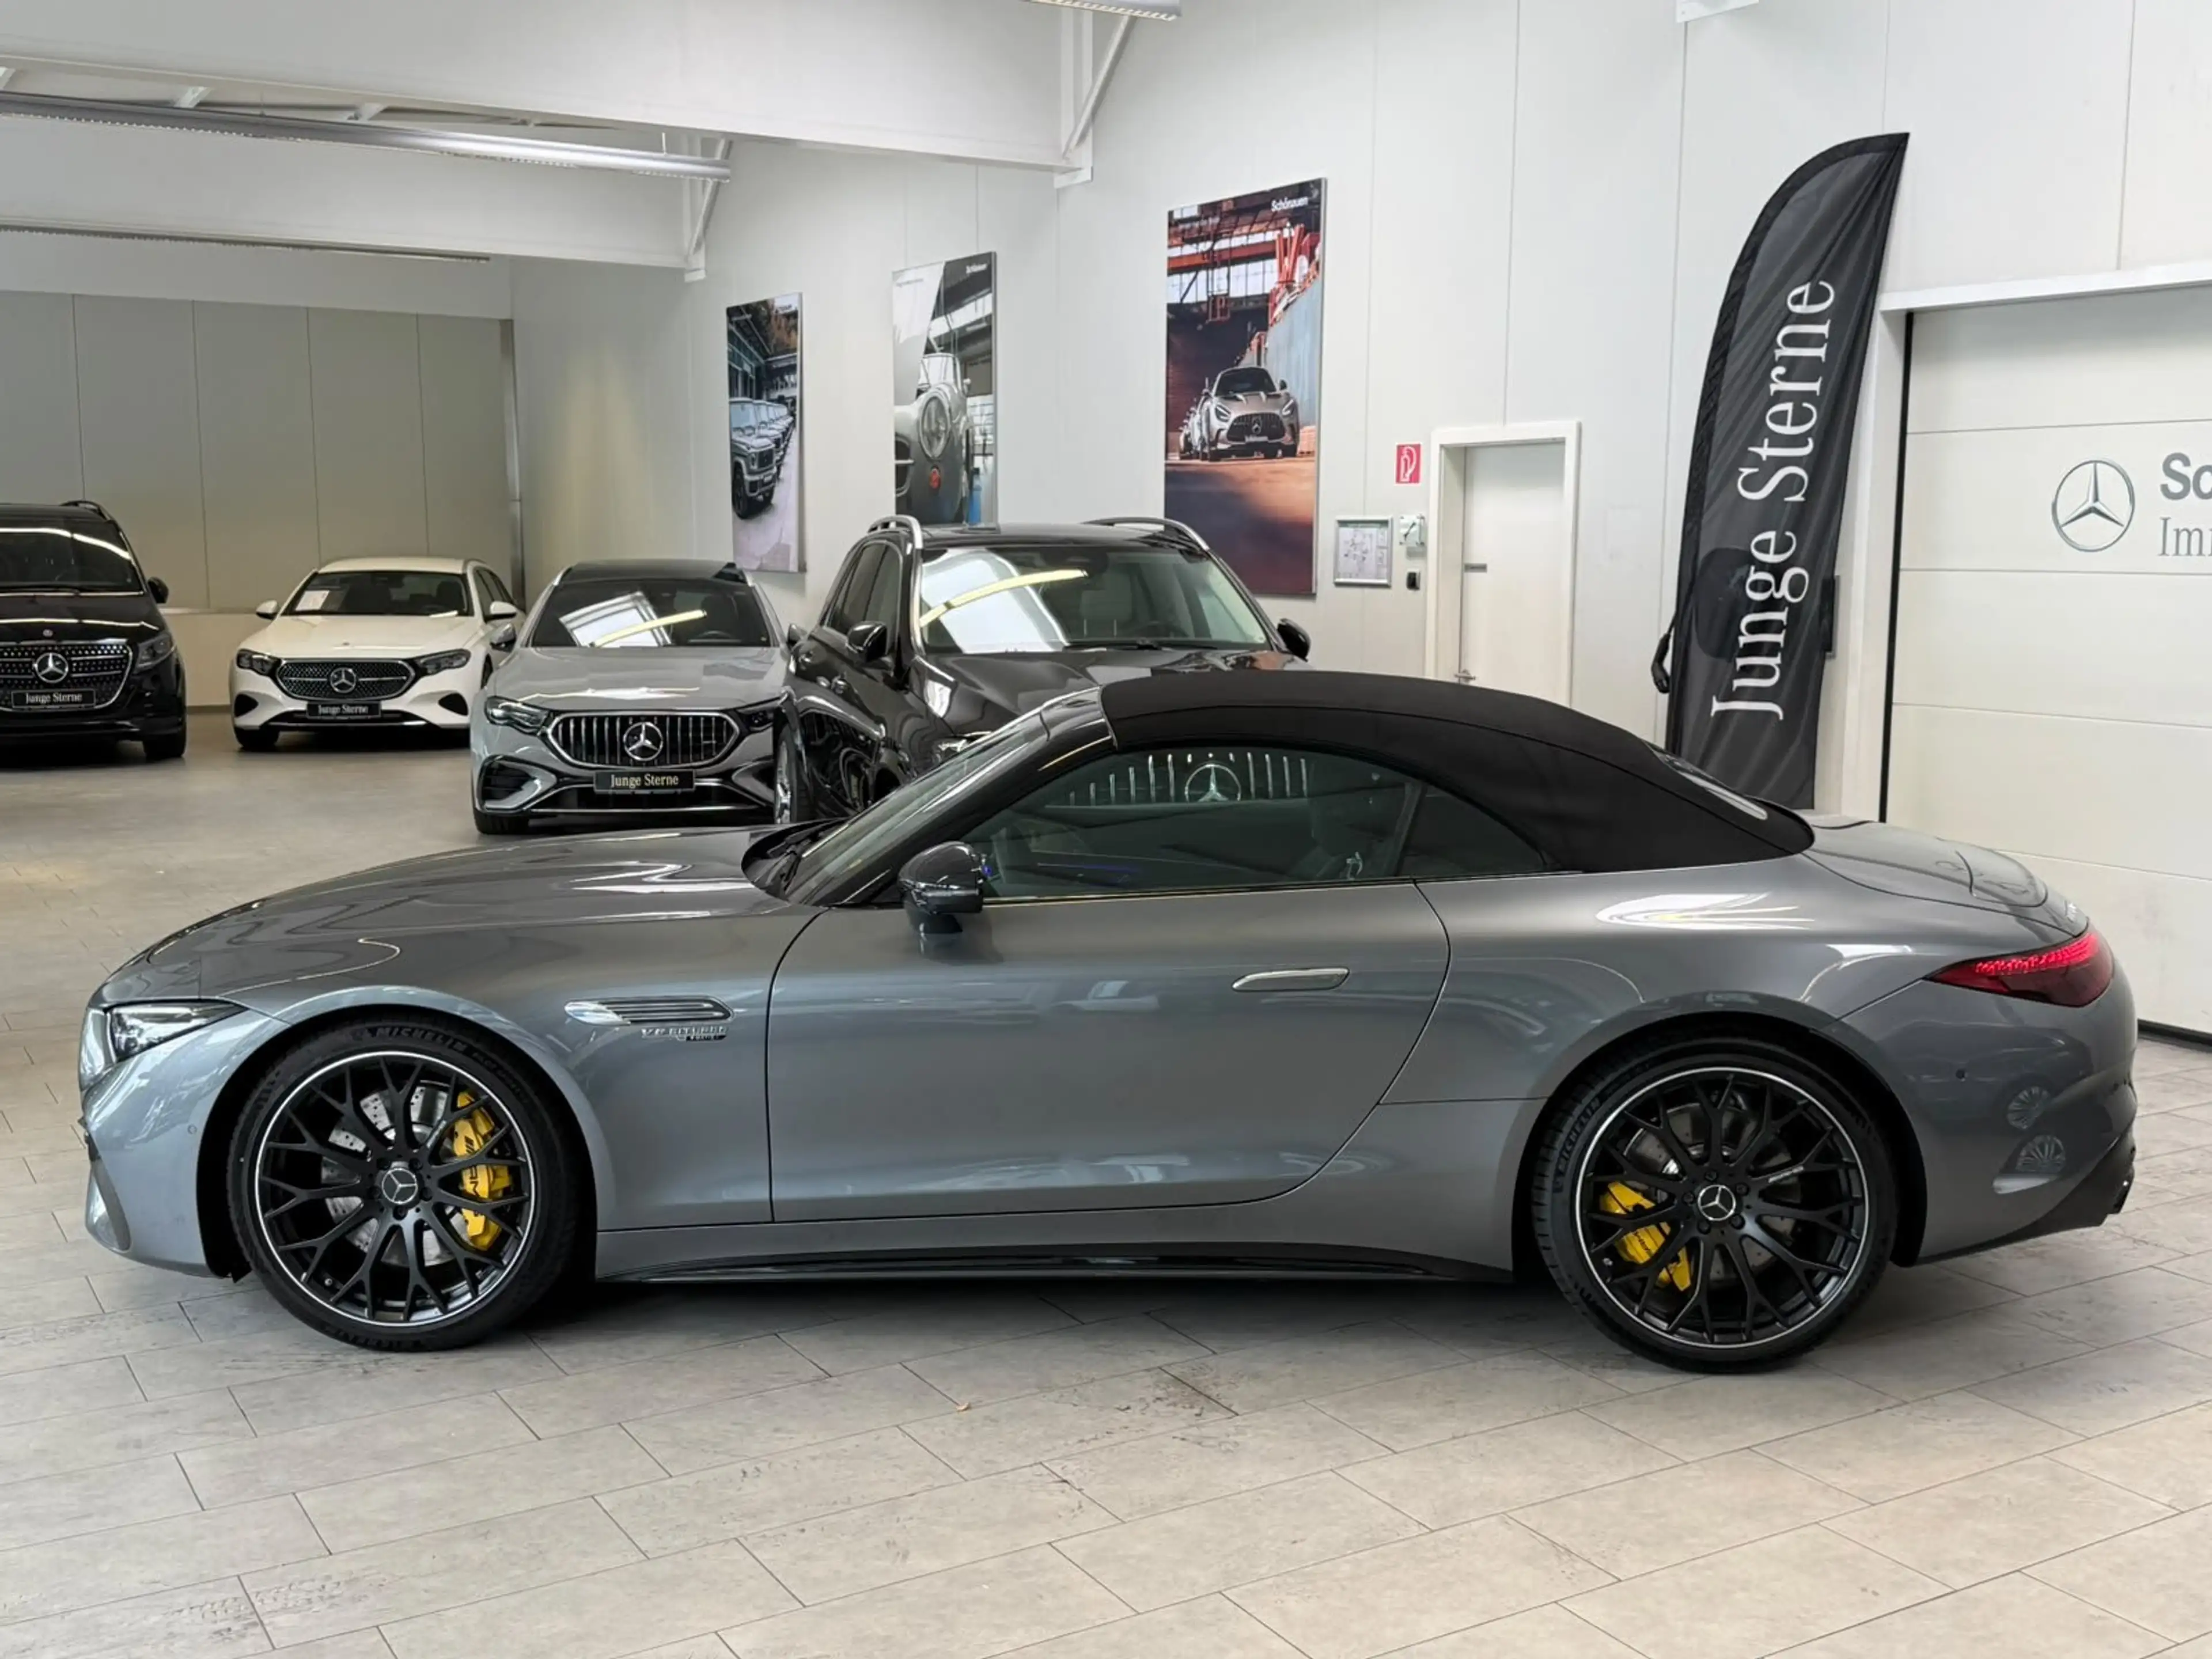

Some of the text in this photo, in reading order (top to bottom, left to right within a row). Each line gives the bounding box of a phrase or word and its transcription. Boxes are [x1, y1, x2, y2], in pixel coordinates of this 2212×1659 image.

[1709, 279, 1835, 721] Junge Sterne
[25, 692, 82, 704] Junge Sterne
[611, 773, 679, 789] Junge Sterne
